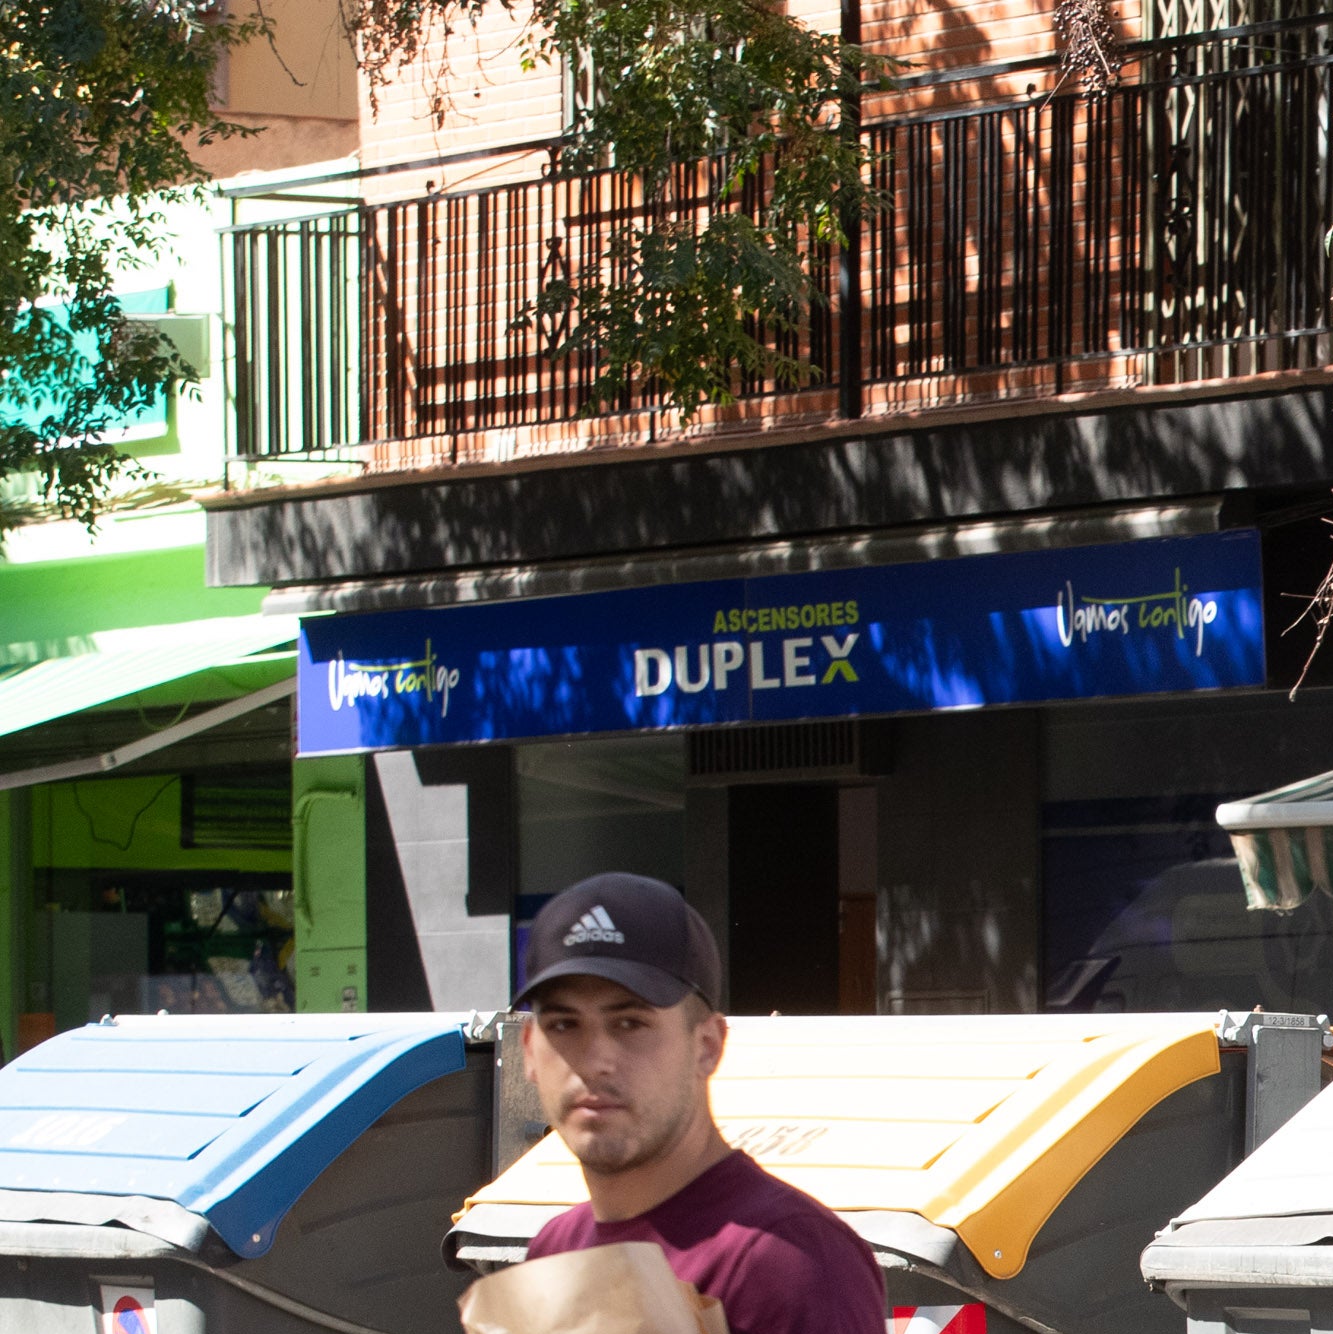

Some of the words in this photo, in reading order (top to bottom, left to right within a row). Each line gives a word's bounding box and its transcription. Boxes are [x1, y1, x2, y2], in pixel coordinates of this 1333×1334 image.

[713, 600, 859, 634] ASCENSORES
[1057, 580, 1129, 648] Vamos
[1137, 567, 1218, 656] contigo
[328, 650, 390, 713] Vamos
[395, 638, 460, 718] contigo
[634, 633, 860, 697] DUPLEX
[562, 929, 625, 947] adidas
[1268, 1016, 1305, 1026] 12-3/1858
[719, 1125, 829, 1156] 858
